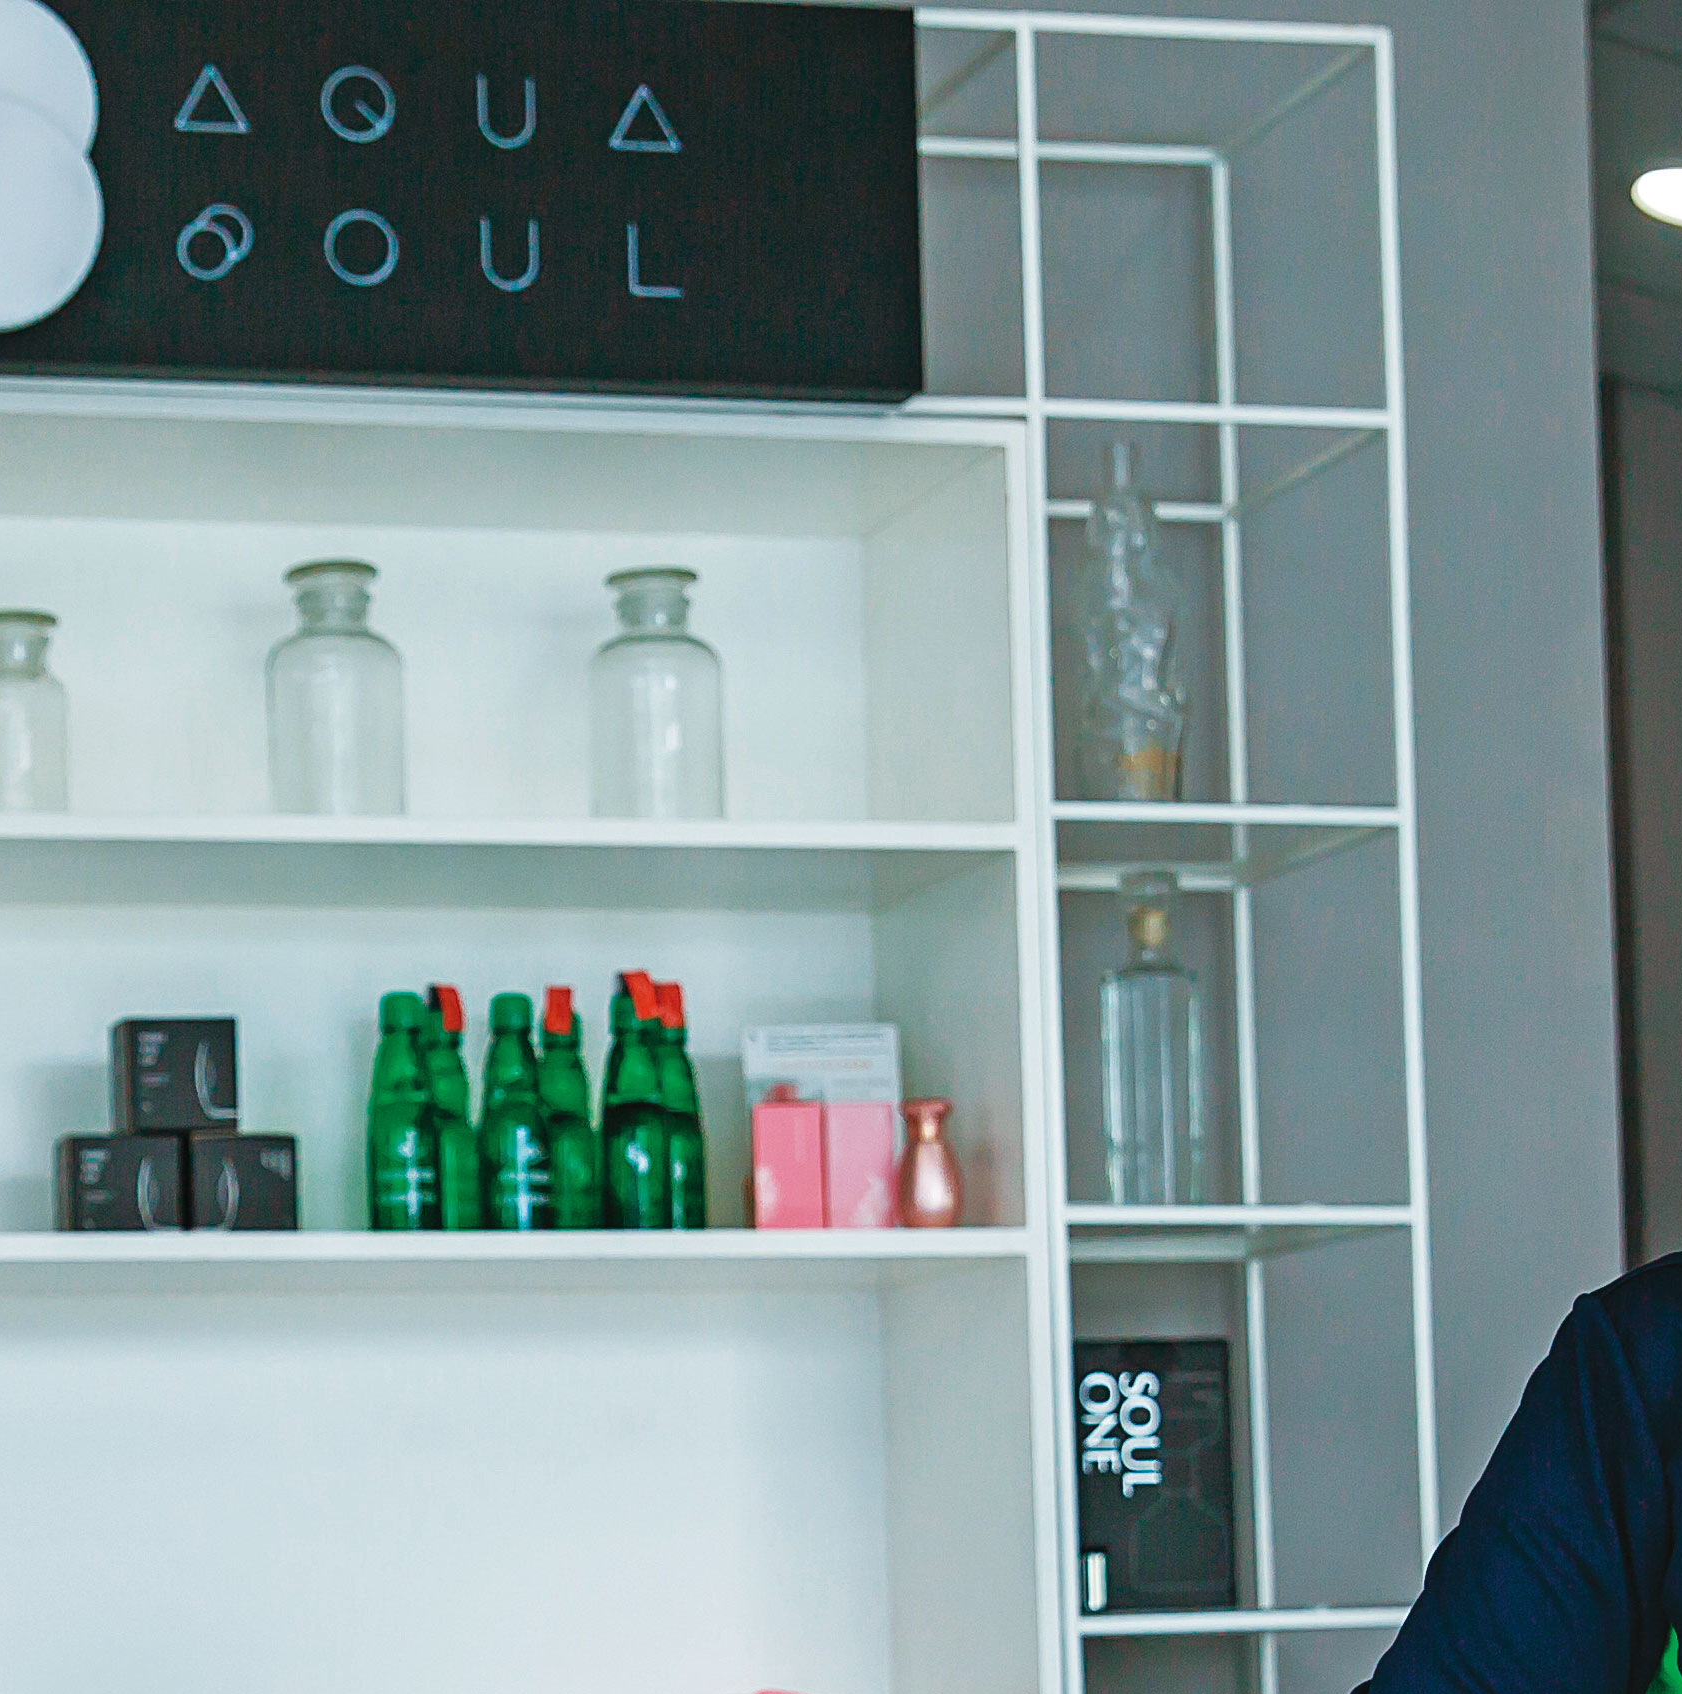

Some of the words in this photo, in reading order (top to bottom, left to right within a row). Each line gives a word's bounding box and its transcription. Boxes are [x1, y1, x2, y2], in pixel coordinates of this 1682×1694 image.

[174, 62, 683, 154] AQUA
[1078, 1370, 1122, 1476] ONE
[1118, 1370, 1163, 1499] SOUL
